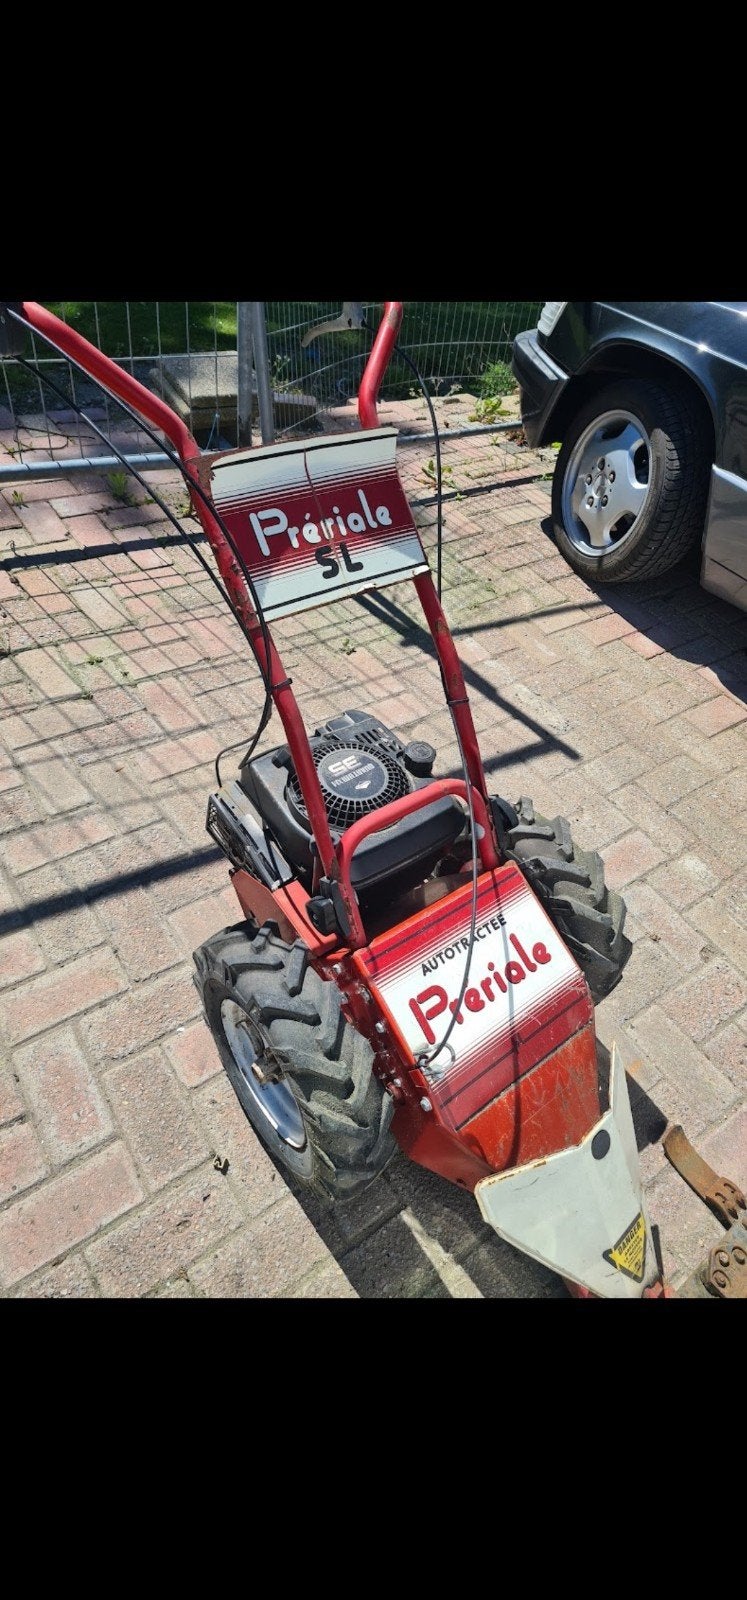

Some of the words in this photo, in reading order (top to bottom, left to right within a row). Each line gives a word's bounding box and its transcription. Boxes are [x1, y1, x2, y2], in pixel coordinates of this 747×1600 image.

[249, 489, 393, 557] Prériale
[314, 542, 364, 579] SL
[328, 755, 362, 777] 35
[421, 913, 507, 977] AUTOTRACTEE
[408, 933, 552, 1045] Preriale
[618, 1221, 642, 1256] DANGER
